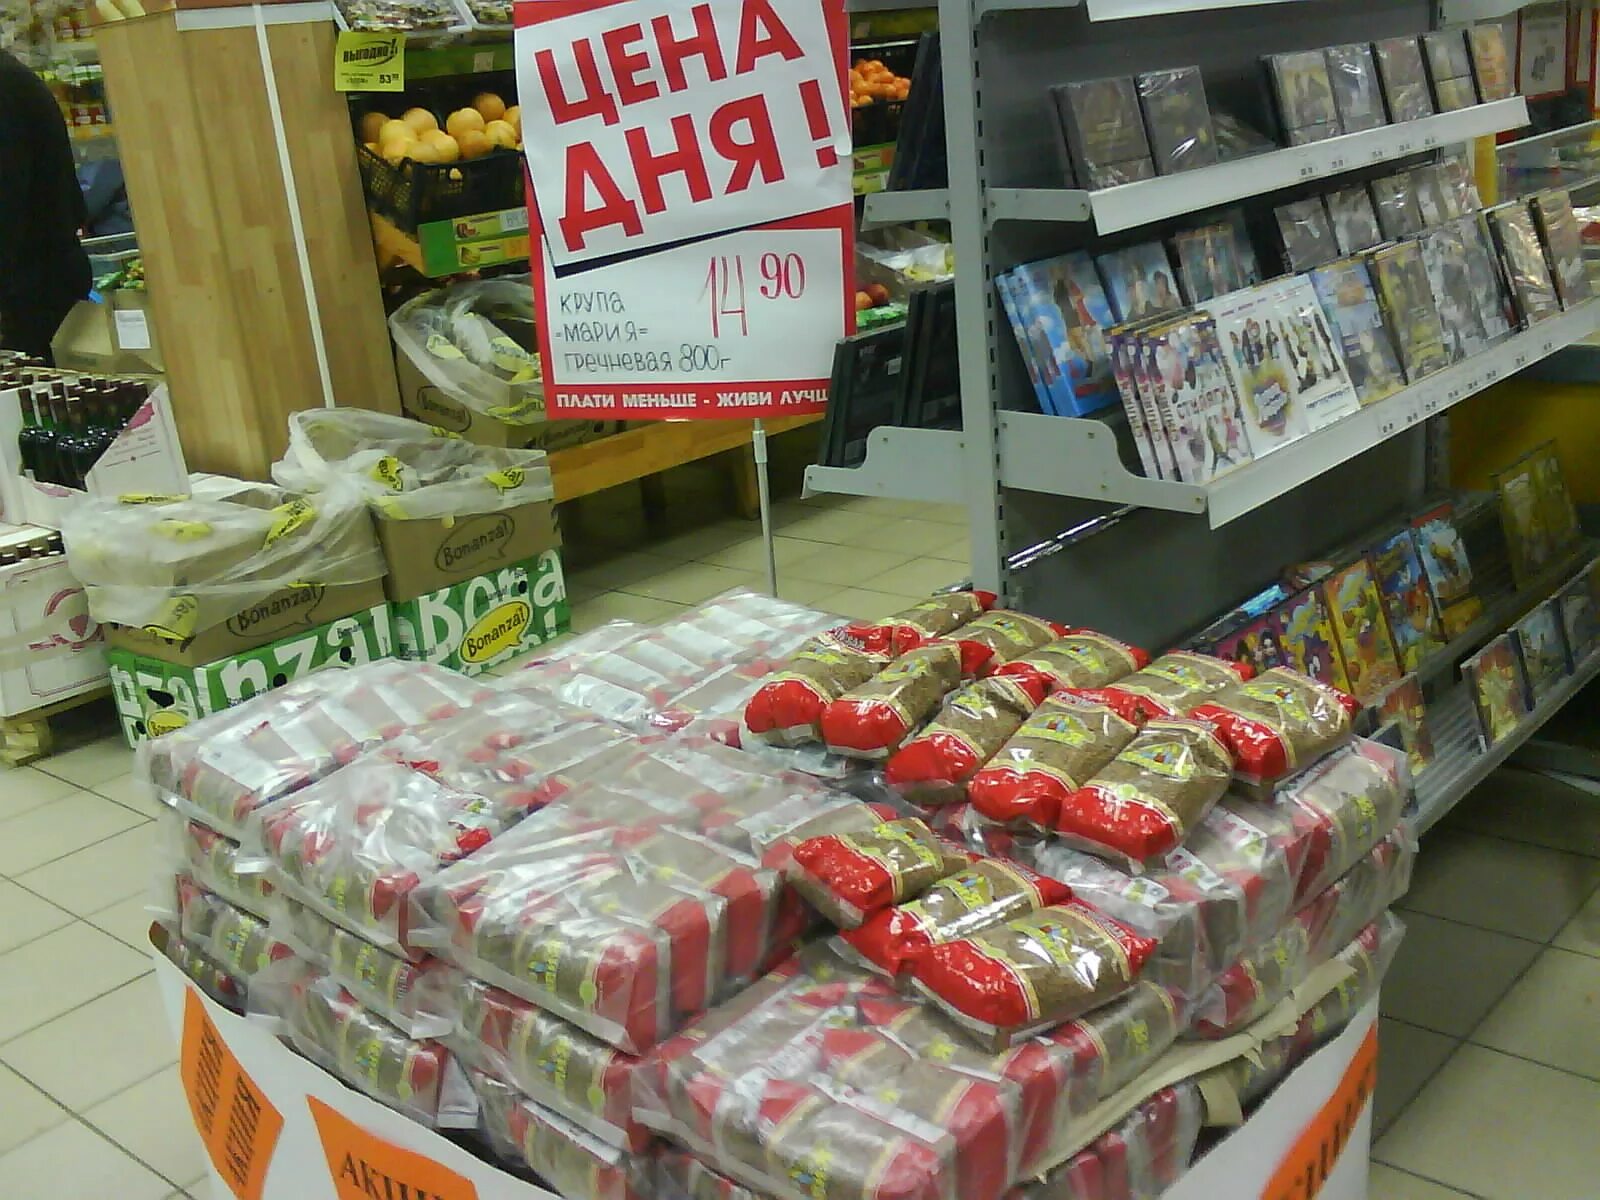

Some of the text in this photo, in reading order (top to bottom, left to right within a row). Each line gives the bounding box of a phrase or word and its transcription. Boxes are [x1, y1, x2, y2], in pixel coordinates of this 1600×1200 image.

[535, 0, 805, 126] ЦЕНА
[556, 393, 615, 408] ПЛАТИ
[622, 393, 697, 408] МЕНЬШЕ
[716, 391, 772, 407] ЖИВИ
[443, 518, 509, 568] Bonanza!
[466, 605, 526, 658] Bonanza!
